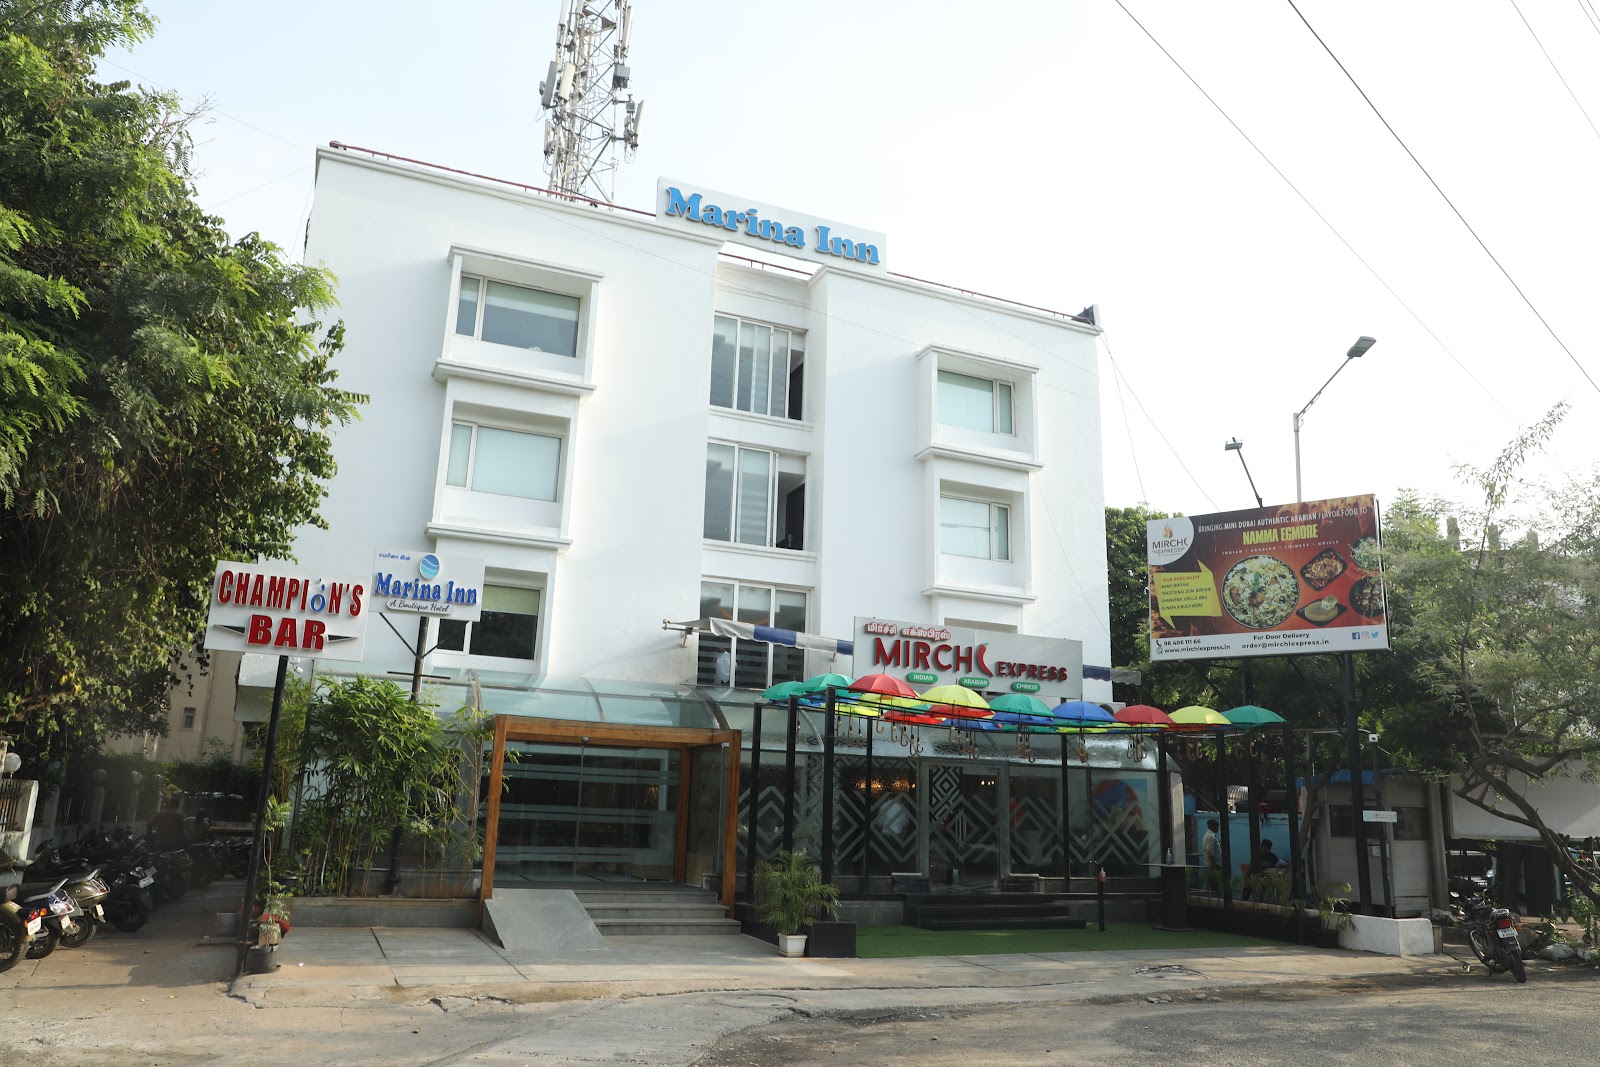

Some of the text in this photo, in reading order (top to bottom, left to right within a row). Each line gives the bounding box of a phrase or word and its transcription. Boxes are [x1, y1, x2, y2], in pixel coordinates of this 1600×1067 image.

[665, 186, 880, 265] Marina Inn
[1198, 507, 1368, 534] BRINGING MINI DUBAI AUTHENTIC ARABIAN FLAVOR FOOD TO
[1242, 524, 1319, 546] NAMMA EGMORE
[218, 570, 364, 617] CHAMPION'S
[374, 572, 477, 605] Marina Inn
[390, 599, 449, 612] A Boutique Hotel
[247, 614, 327, 651] BAR
[1282, 632, 1310, 640] Delivery
[1164, 644, 1231, 653] www.mirchiexpress.in
[1242, 639, 1330, 649] order@mirchiexpress.in
[996, 661, 1068, 682] EXPRESS
[963, 678, 988, 686] ARABIAN
[1016, 683, 1039, 691] CHINESE
